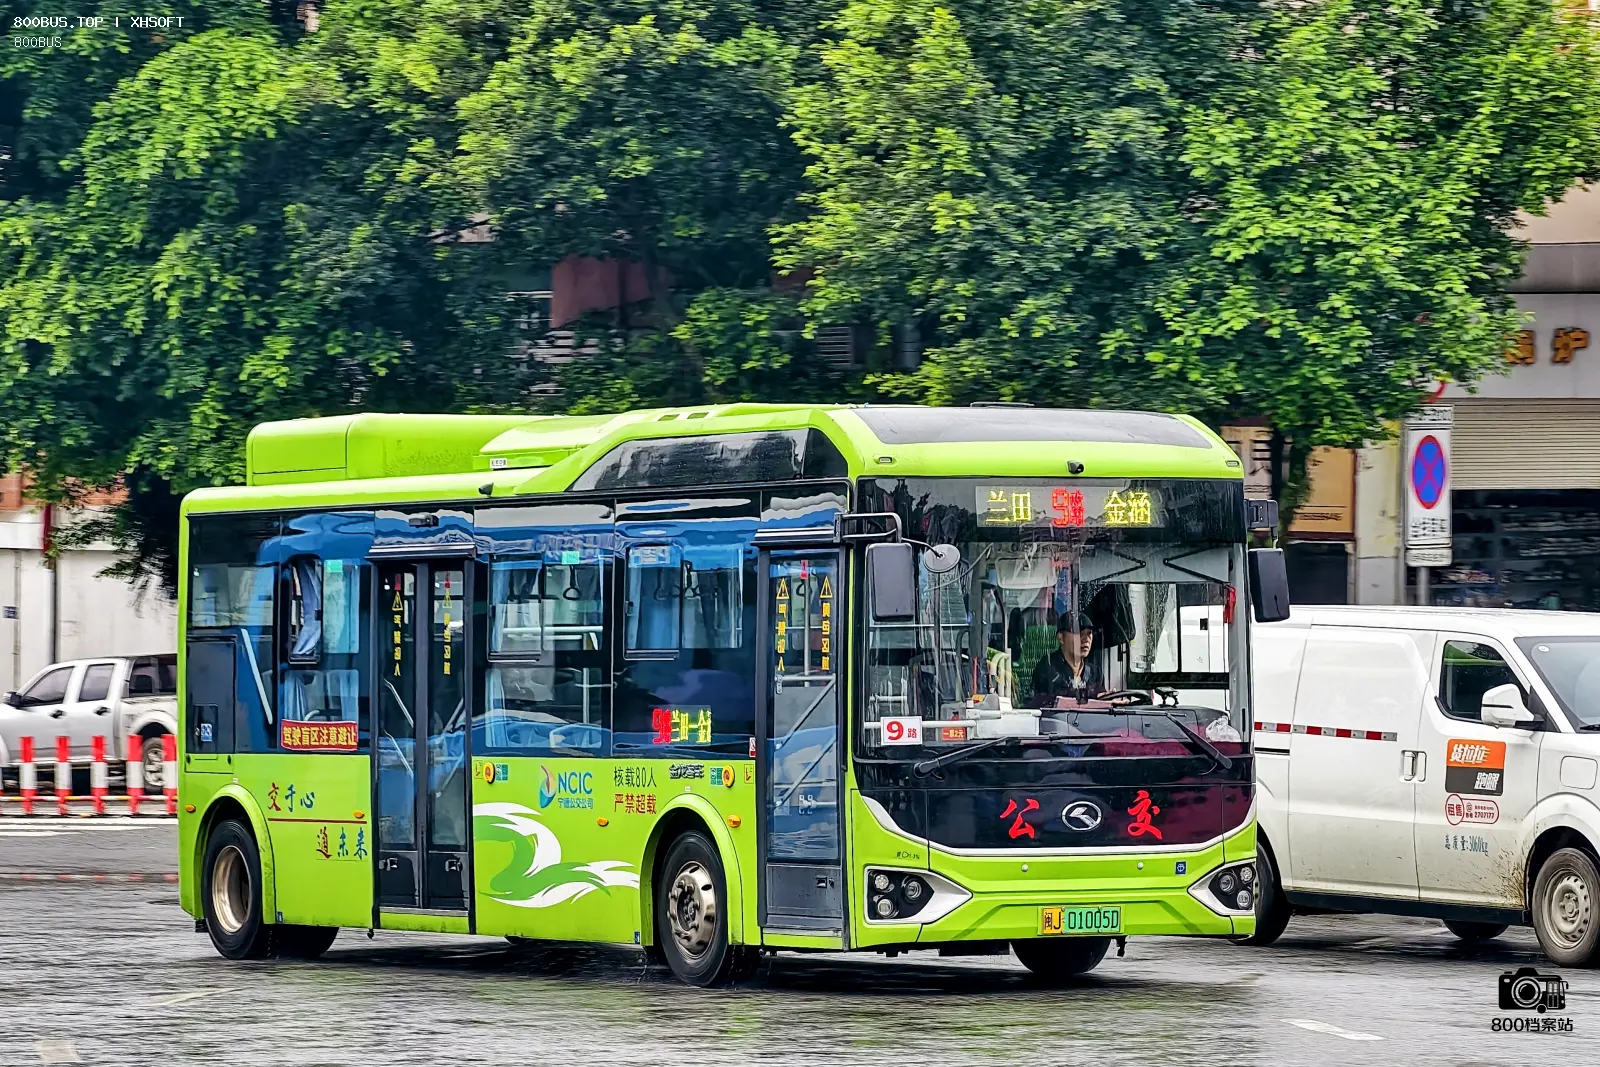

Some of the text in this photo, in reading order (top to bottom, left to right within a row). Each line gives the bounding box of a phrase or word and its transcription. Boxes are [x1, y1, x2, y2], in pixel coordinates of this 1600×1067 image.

[985, 490, 1032, 522] 兰田
[1105, 490, 1152, 525] 金涵
[283, 726, 358, 746] 驾驶盲区注意避让
[1449, 743, 1491, 765] 货拉拉
[558, 771, 593, 795] NCIC
[613, 766, 658, 789] 核载80人
[613, 793, 658, 815] 严禁超载
